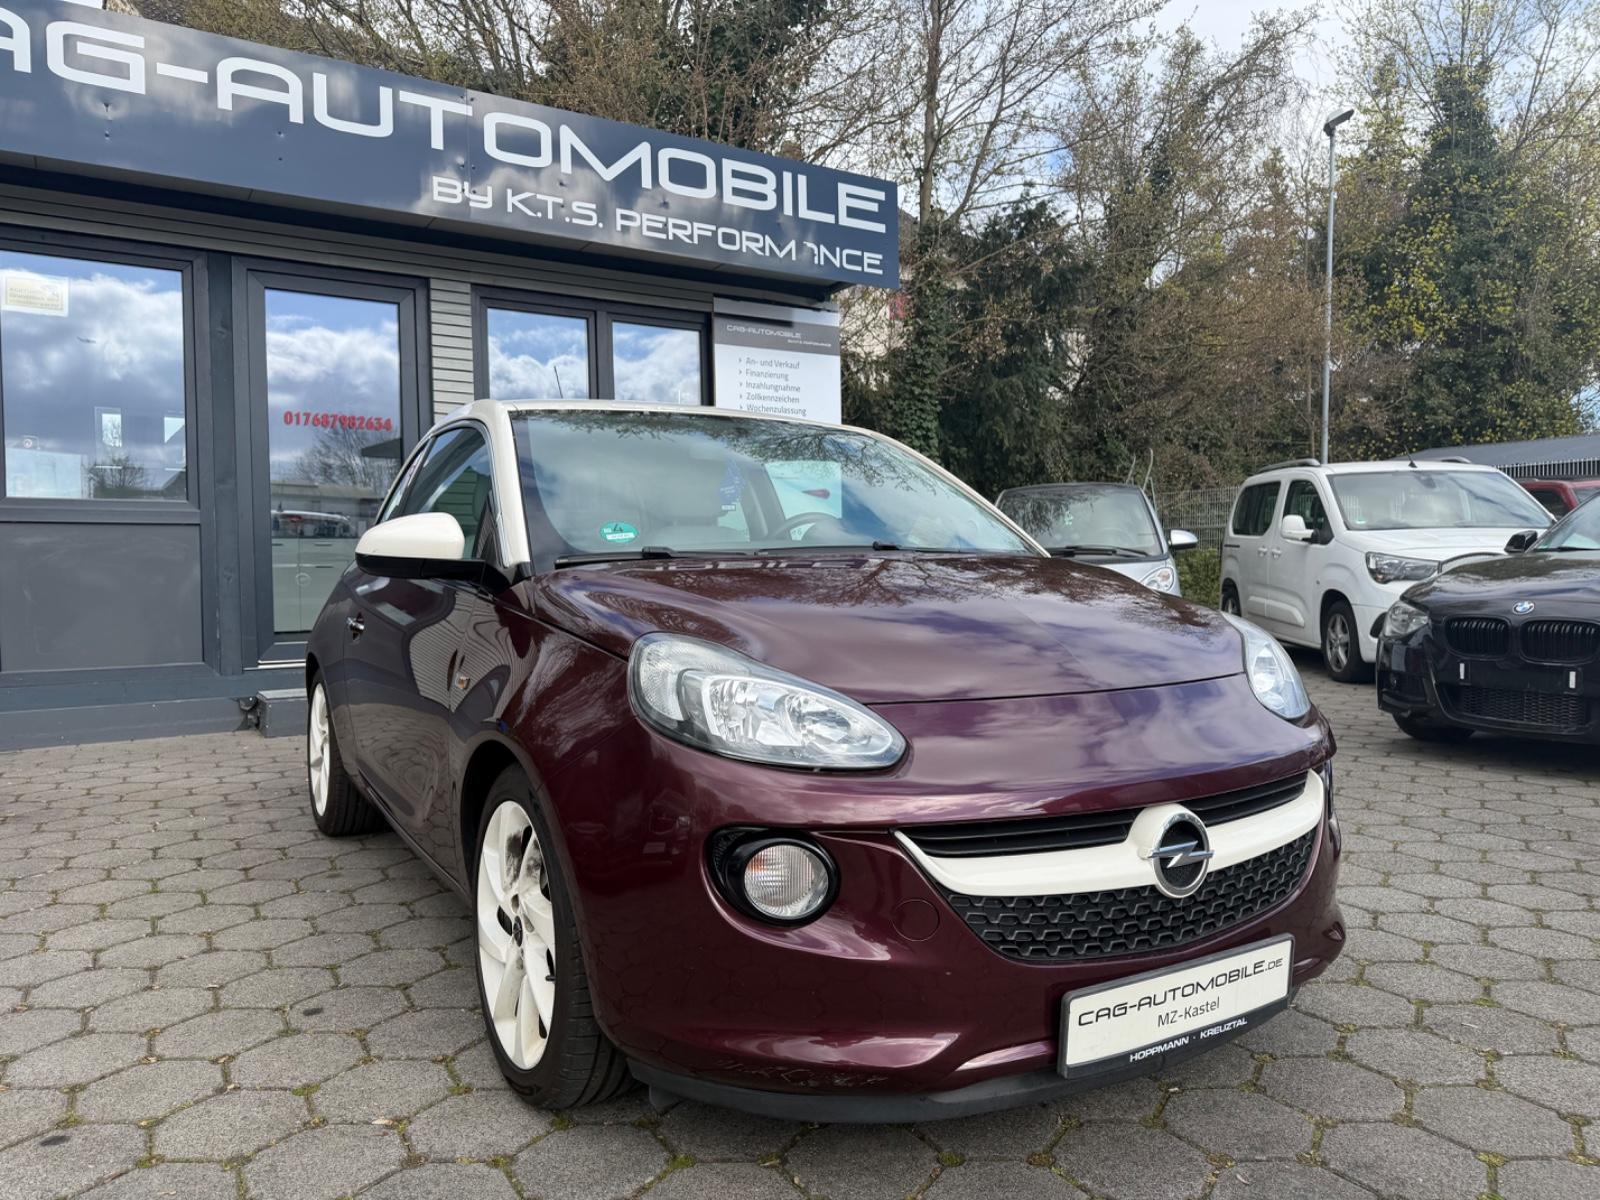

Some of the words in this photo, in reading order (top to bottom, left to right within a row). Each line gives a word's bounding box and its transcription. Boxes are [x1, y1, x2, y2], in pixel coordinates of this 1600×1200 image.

[507, 188, 603, 228] K.T.S.
[774, 360, 800, 369] Verkauf
[745, 369, 789, 381] Finanzierung
[745, 380, 801, 392] Inzahlungnahme
[746, 392, 800, 404] Zollkennzeichen
[746, 404, 807, 417] Wochenzulassung
[1078, 958, 1284, 1027] CAG-AUTOMOBILE.DE
[1157, 997, 1220, 1028] MZ-Kastel
[1129, 1036, 1190, 1063] HOPPMANN
[1199, 1017, 1248, 1040] KREUZTAL
